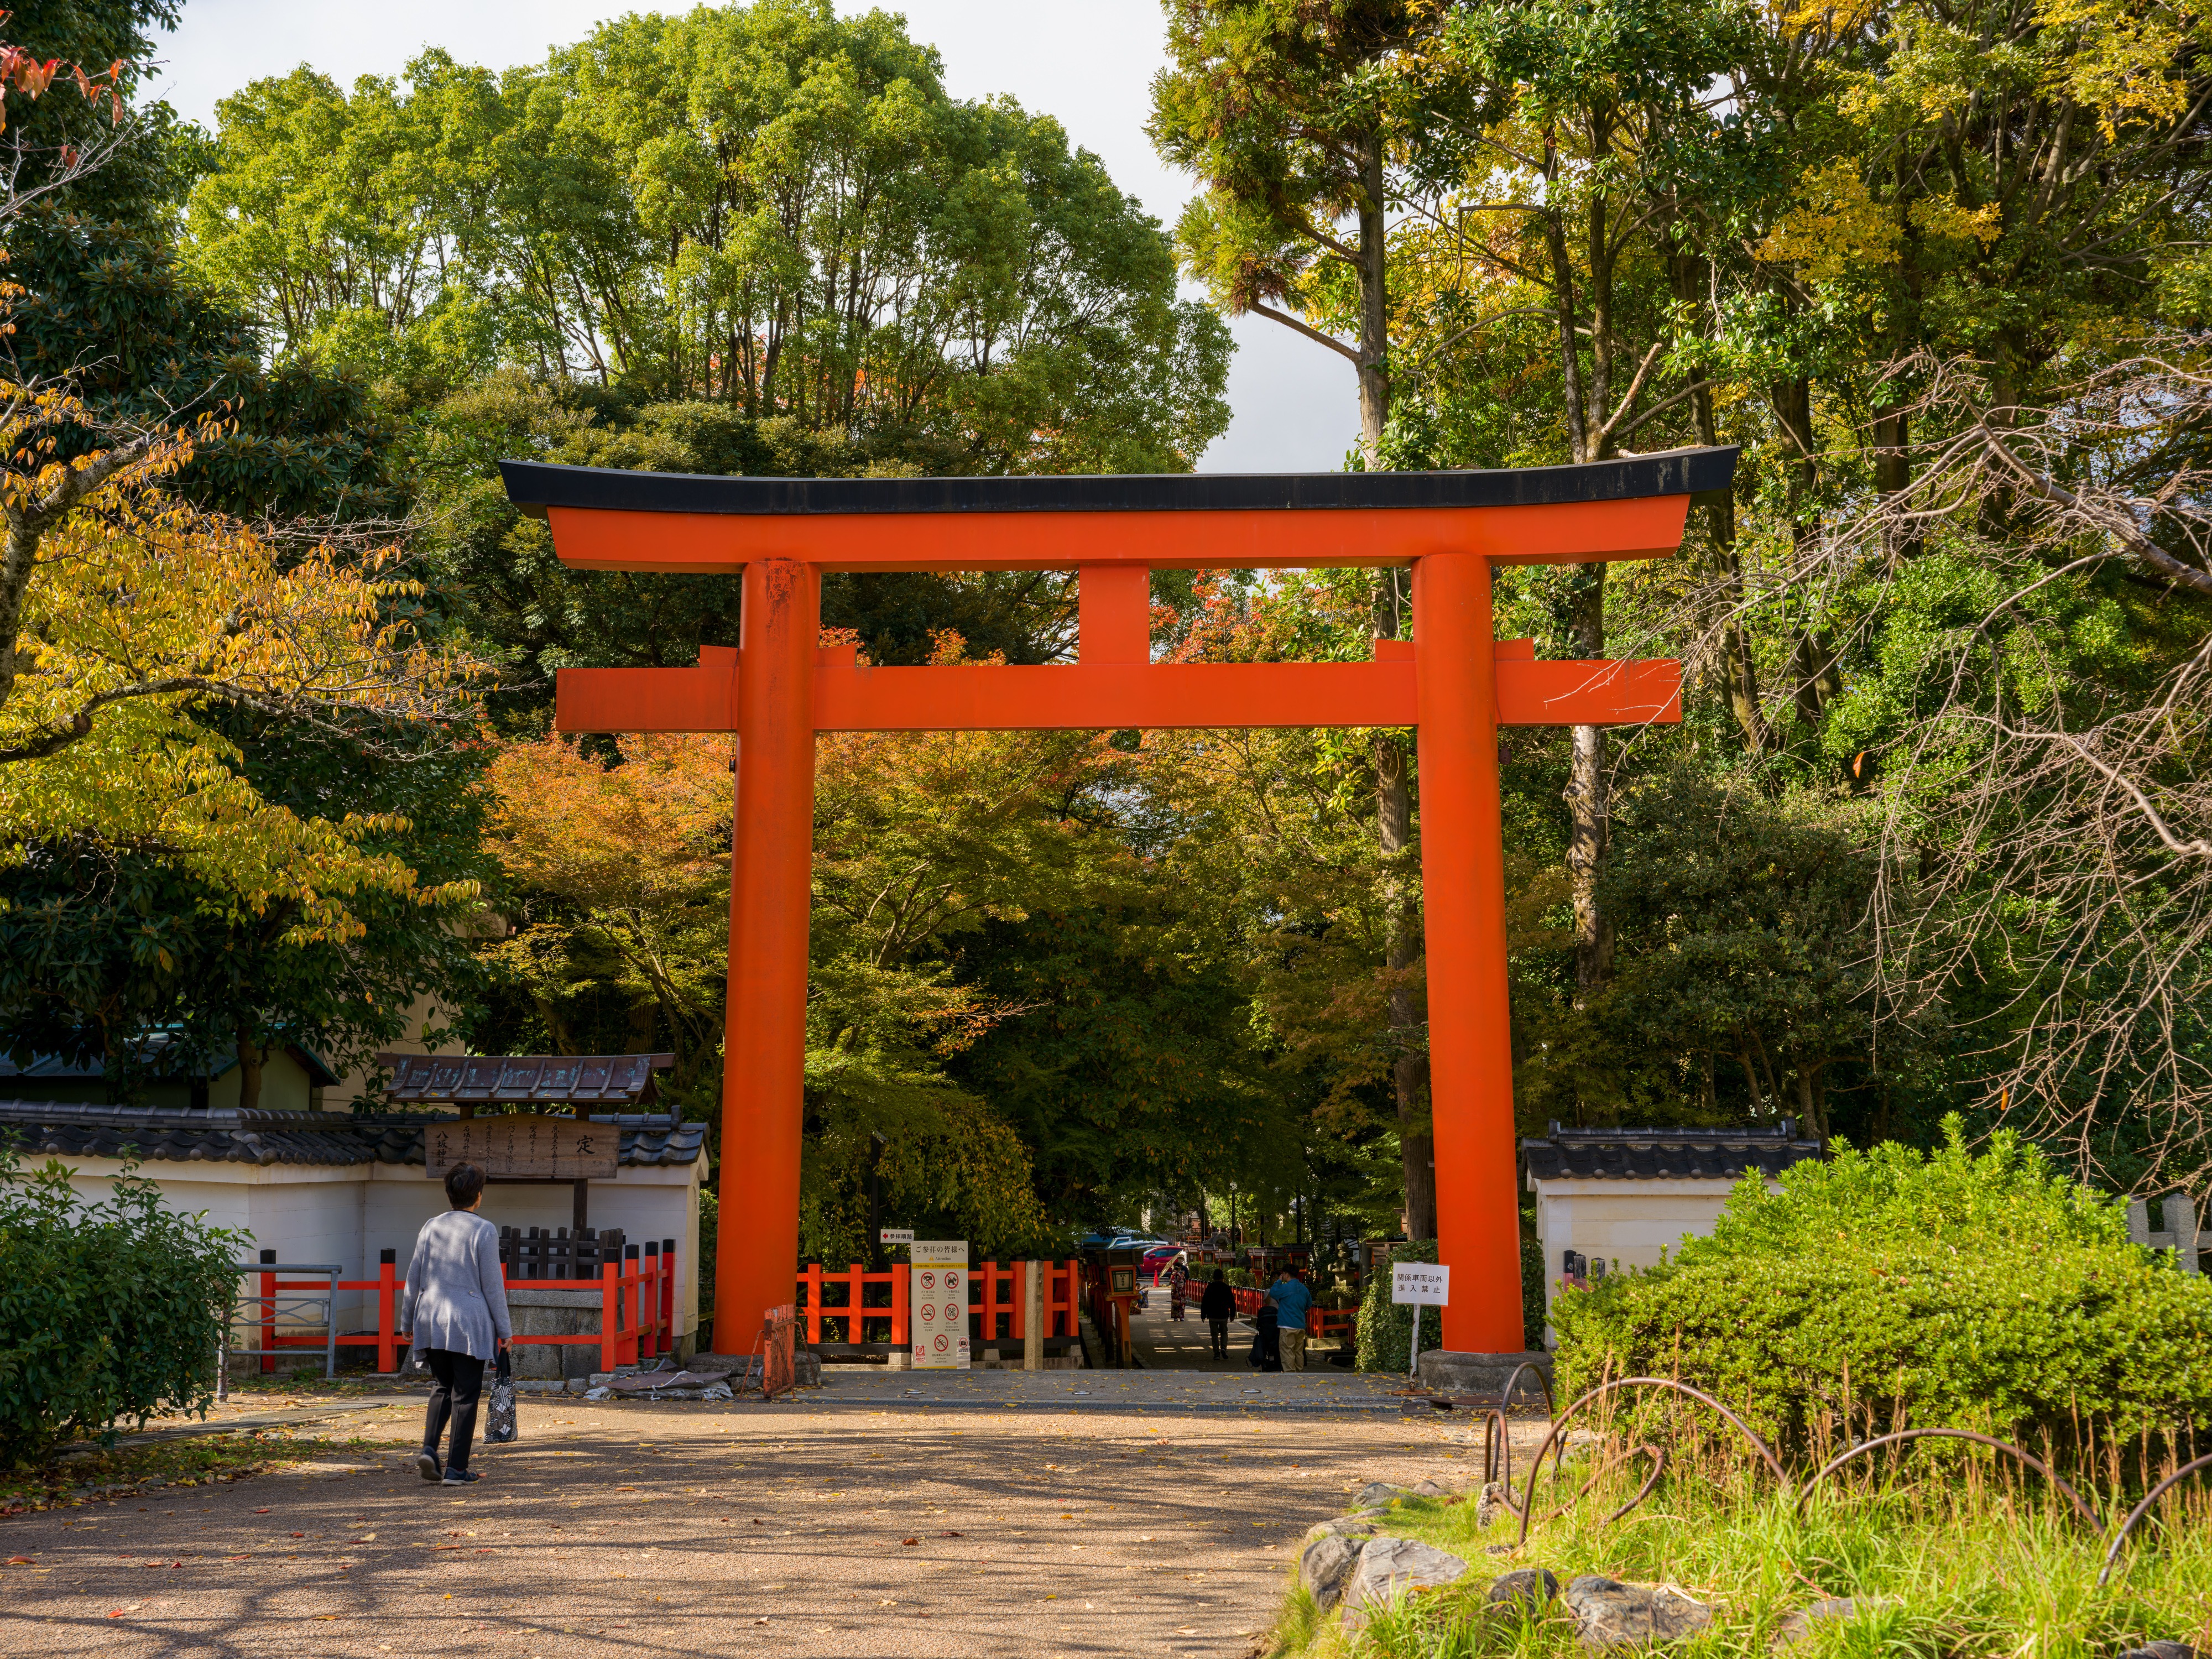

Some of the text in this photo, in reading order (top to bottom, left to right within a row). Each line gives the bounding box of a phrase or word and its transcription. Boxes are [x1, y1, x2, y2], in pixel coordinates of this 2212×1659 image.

[436, 1130, 448, 1167] 八坂神社
[576, 1135, 596, 1155] 定
[1397, 1274, 1443, 1283] 関係車両以外
[1398, 1284, 1441, 1293] 進入禁止
